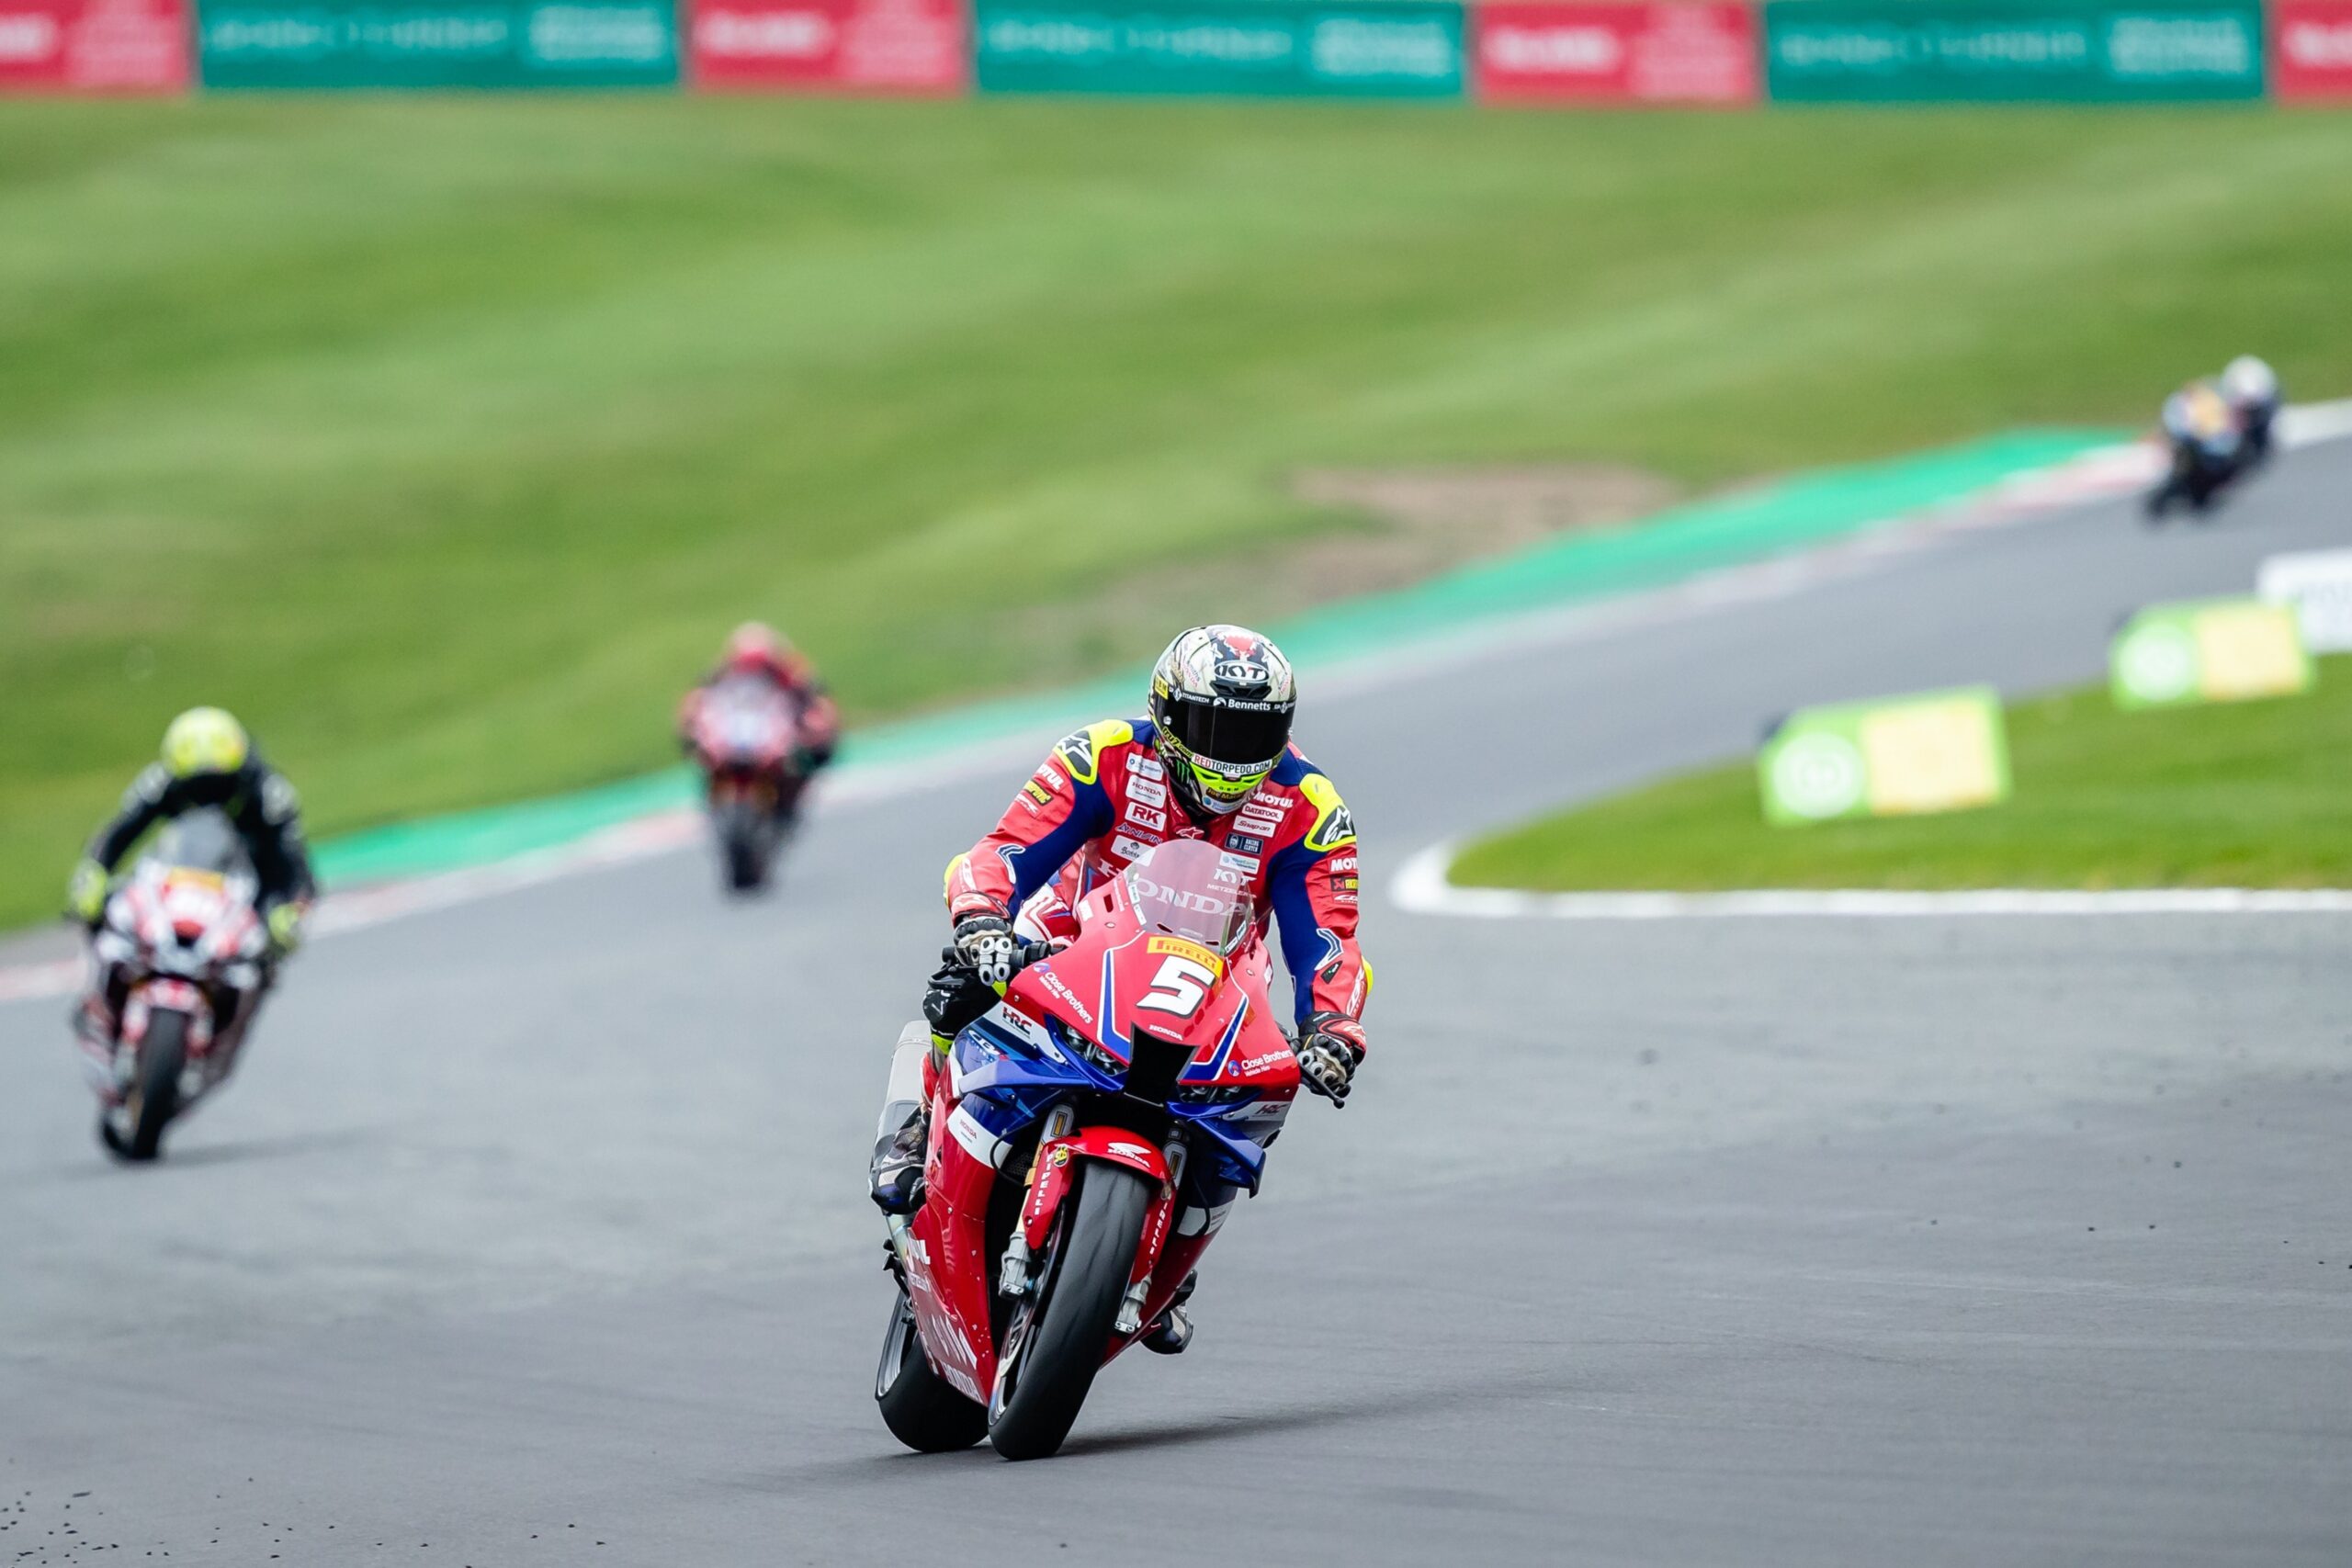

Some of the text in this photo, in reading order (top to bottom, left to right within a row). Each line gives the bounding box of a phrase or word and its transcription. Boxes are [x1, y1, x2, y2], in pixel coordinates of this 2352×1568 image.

[1221, 664, 1263, 679] KYT
[1227, 698, 1271, 711] Bennetts
[1194, 754, 1271, 773] REDTORPEDO.COM
[1132, 782, 1162, 796] HONDA
[1253, 792, 1294, 808] MOTUL
[1132, 805, 1161, 825] RK
[1244, 806, 1279, 818] DATATOOL
[1238, 820, 1271, 831] Snap-on
[1157, 940, 1218, 969] PIRELLI
[1136, 954, 1216, 1019] 5
[1044, 971, 1093, 1024] Close Brothers
[1001, 1007, 1033, 1035] HRC
[1149, 1024, 1183, 1041] HONDA
[1241, 1049, 1294, 1070] Close Brothers
[1107, 1148, 1151, 1168] HONDA
